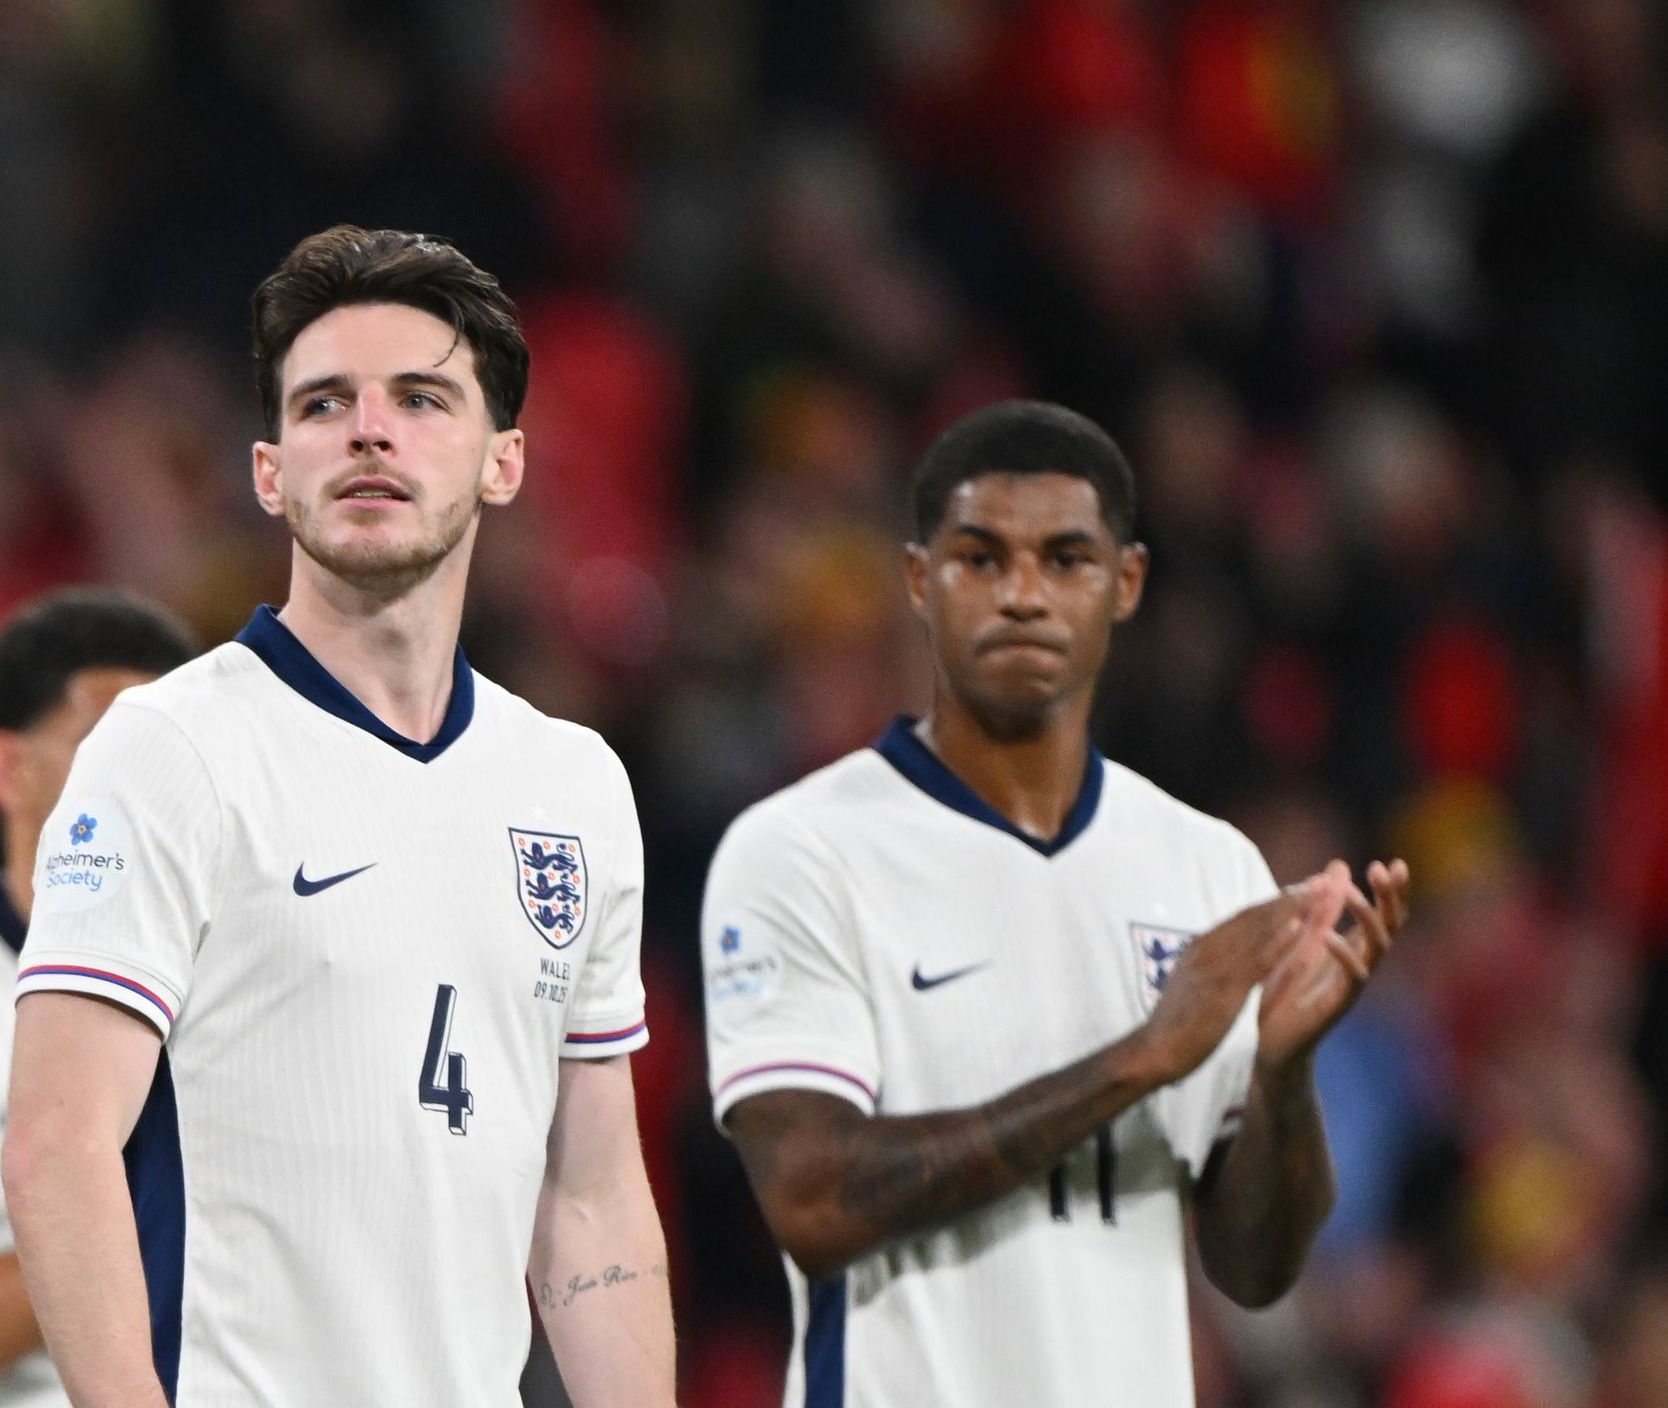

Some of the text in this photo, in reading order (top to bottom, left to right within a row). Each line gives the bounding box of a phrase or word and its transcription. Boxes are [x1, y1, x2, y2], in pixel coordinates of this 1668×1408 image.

[46, 850, 125, 871] heimer's
[540, 958, 570, 980] WALE
[419, 984, 473, 1136] 4
